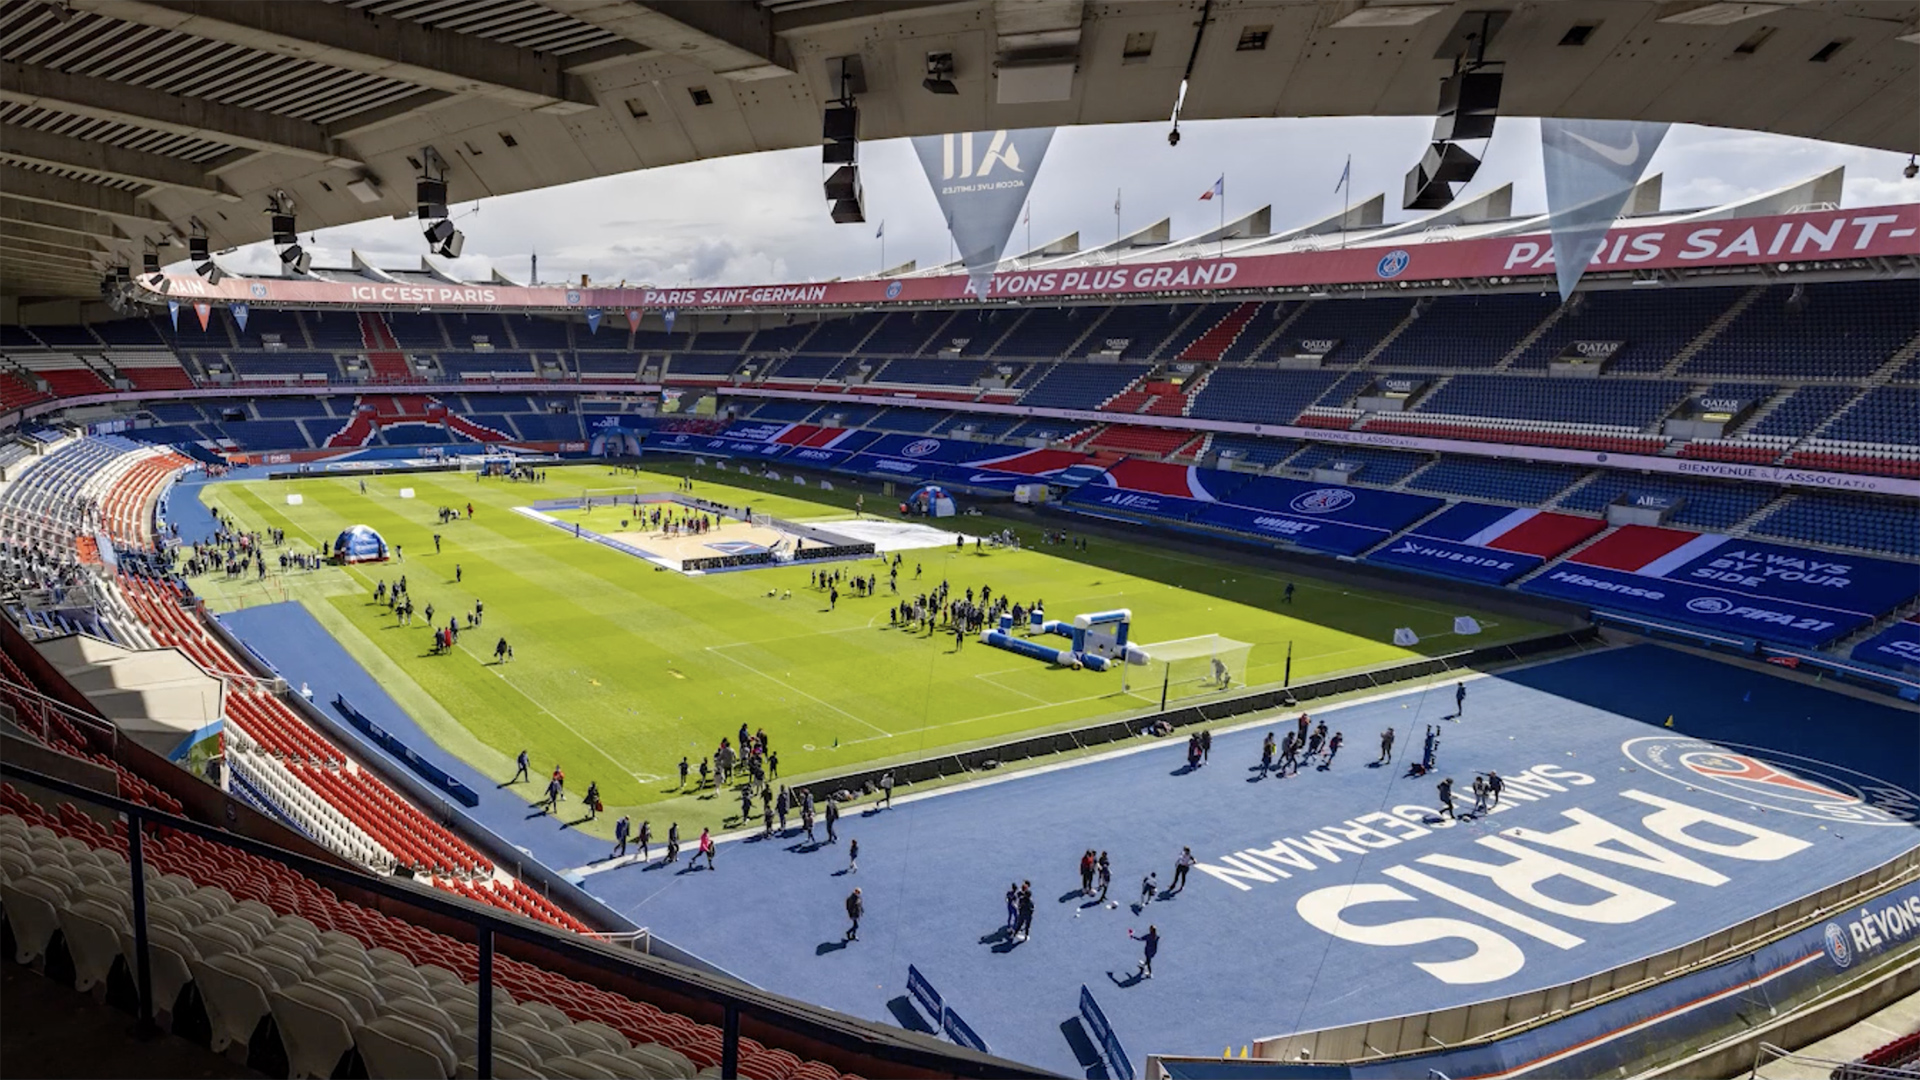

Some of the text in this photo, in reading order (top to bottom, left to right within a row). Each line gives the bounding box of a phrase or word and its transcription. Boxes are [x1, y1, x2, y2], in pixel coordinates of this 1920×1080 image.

[1677, 214, 1917, 260] SAINT-
[963, 262, 1238, 296] RVONS PLUS GRAND
[352, 286, 496, 303] ICI C'EST PARIS
[644, 285, 828, 304] PARIS SAINT-GERMAIN
[1302, 339, 1333, 349] QATAR
[1577, 342, 1619, 353] QATAR
[1386, 380, 1411, 389] QATAR
[1701, 398, 1739, 408] QATAR
[1678, 462, 1757, 477] BIENVENUE
[1253, 516, 1320, 533] UNIBET
[1422, 547, 1515, 570] HUBSIDE
[1723, 550, 1853, 575] ALWAYS
[1690, 568, 1766, 588] SIDE
[1708, 558, 1852, 589] BY YOUR
[1549, 570, 1666, 601] Hisense
[1725, 606, 1796, 626] FIFA
[1789, 618, 1835, 632] 21
[1295, 789, 1815, 985] PARIS
[1848, 895, 1920, 953] RÊVONS
